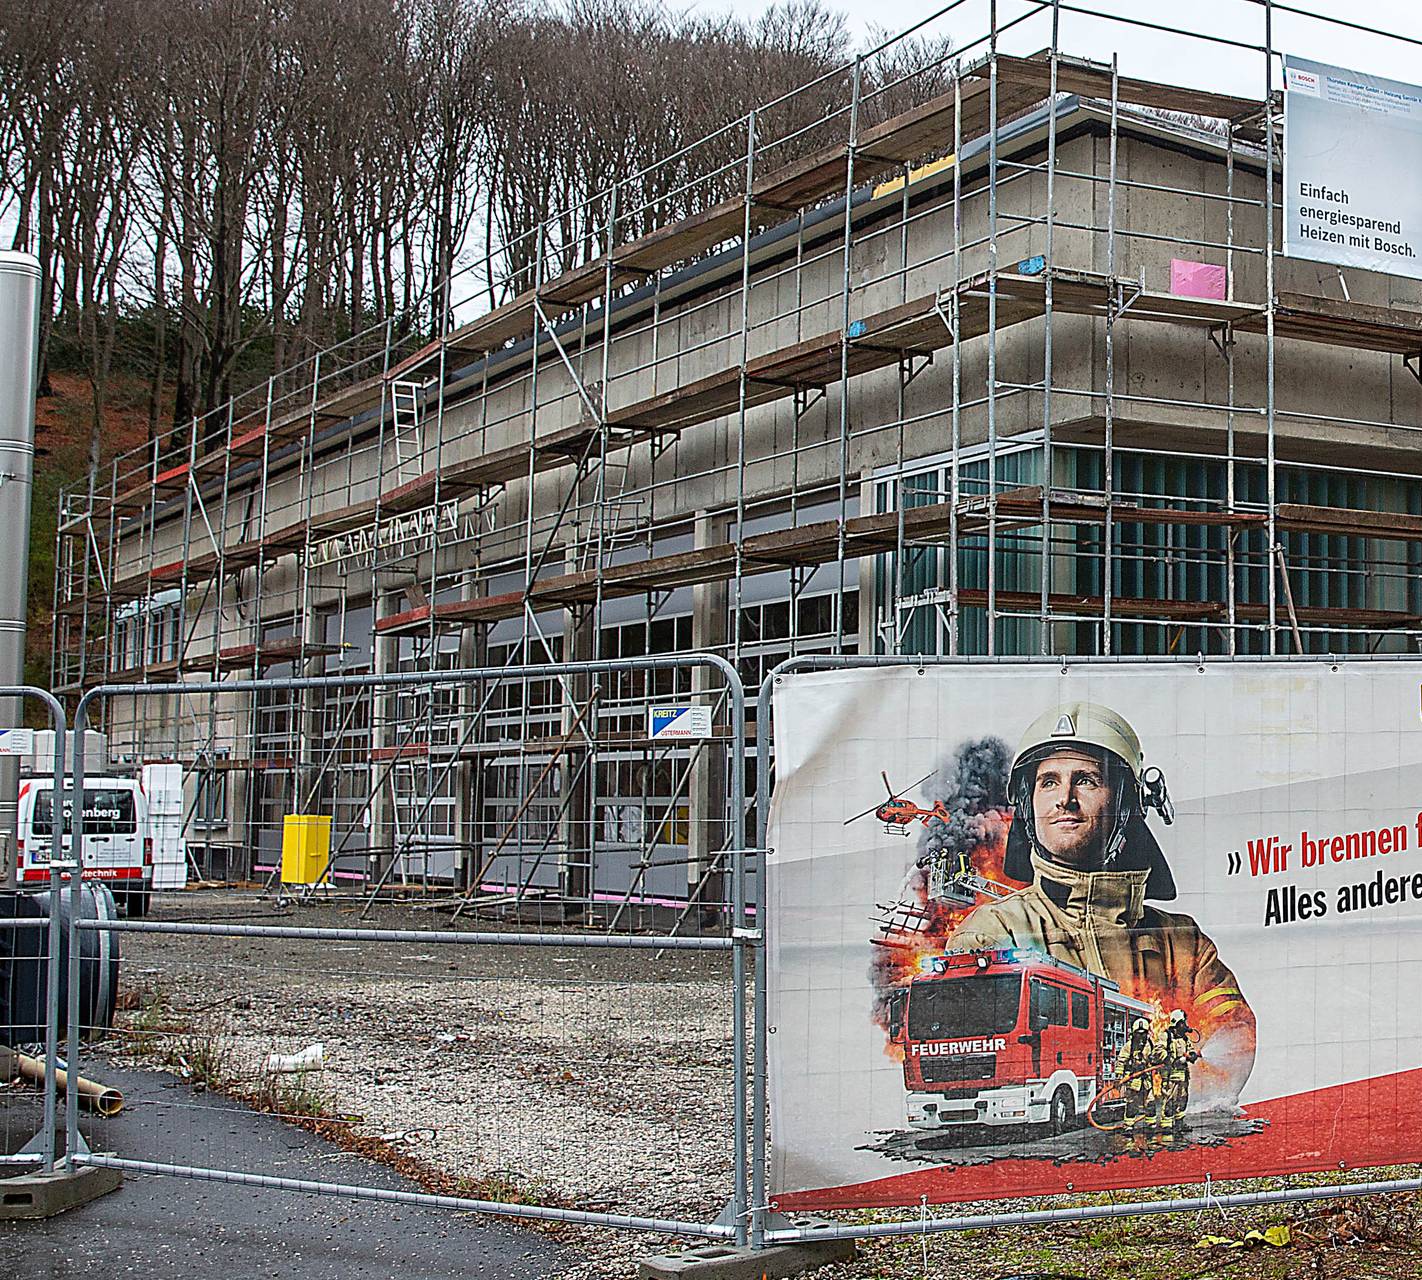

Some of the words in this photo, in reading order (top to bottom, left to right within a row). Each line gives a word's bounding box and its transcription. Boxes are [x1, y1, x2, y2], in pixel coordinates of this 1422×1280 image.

[1299, 182, 1349, 205] Einfach
[1299, 205, 1401, 235] energiesparend
[1299, 223, 1345, 245] Heizen
[1349, 234, 1371, 250] mit
[1374, 237, 1416, 258] Bosch.
[653, 710, 677, 718] KREITZ
[1247, 836, 1292, 877] Wir
[1301, 824, 1408, 869] brennen
[1264, 885, 1328, 927] Alles
[911, 1037, 1007, 1057] FEUERWEHR
